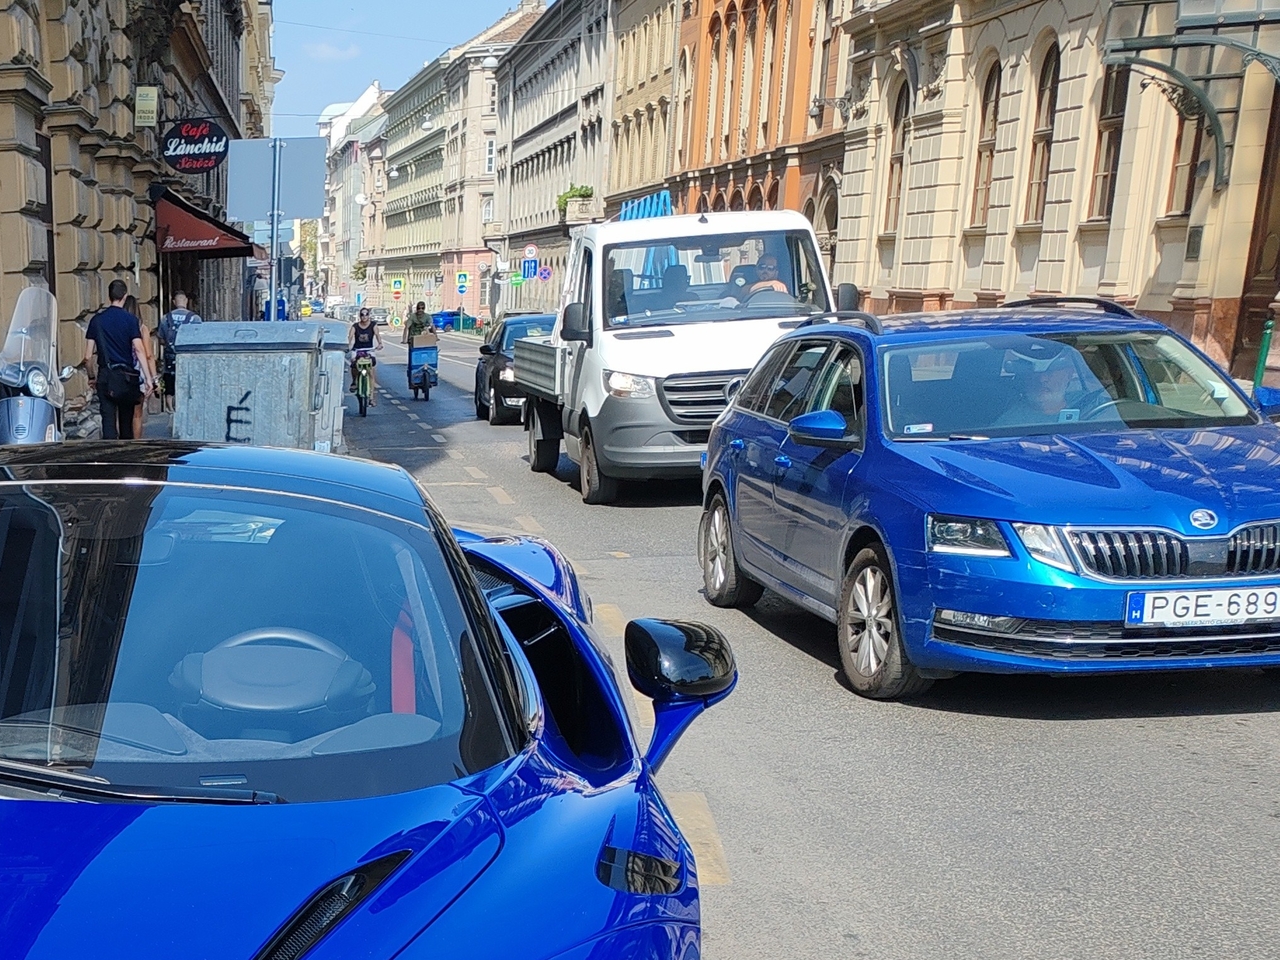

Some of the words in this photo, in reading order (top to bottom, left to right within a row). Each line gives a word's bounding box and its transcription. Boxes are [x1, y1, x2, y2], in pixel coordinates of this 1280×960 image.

[181, 122, 210, 139] Café
[162, 236, 220, 248] Restaurant
[225, 390, 252, 442] É
[1131, 610, 1141, 619] H
[1150, 591, 1278, 619] PGE-689
